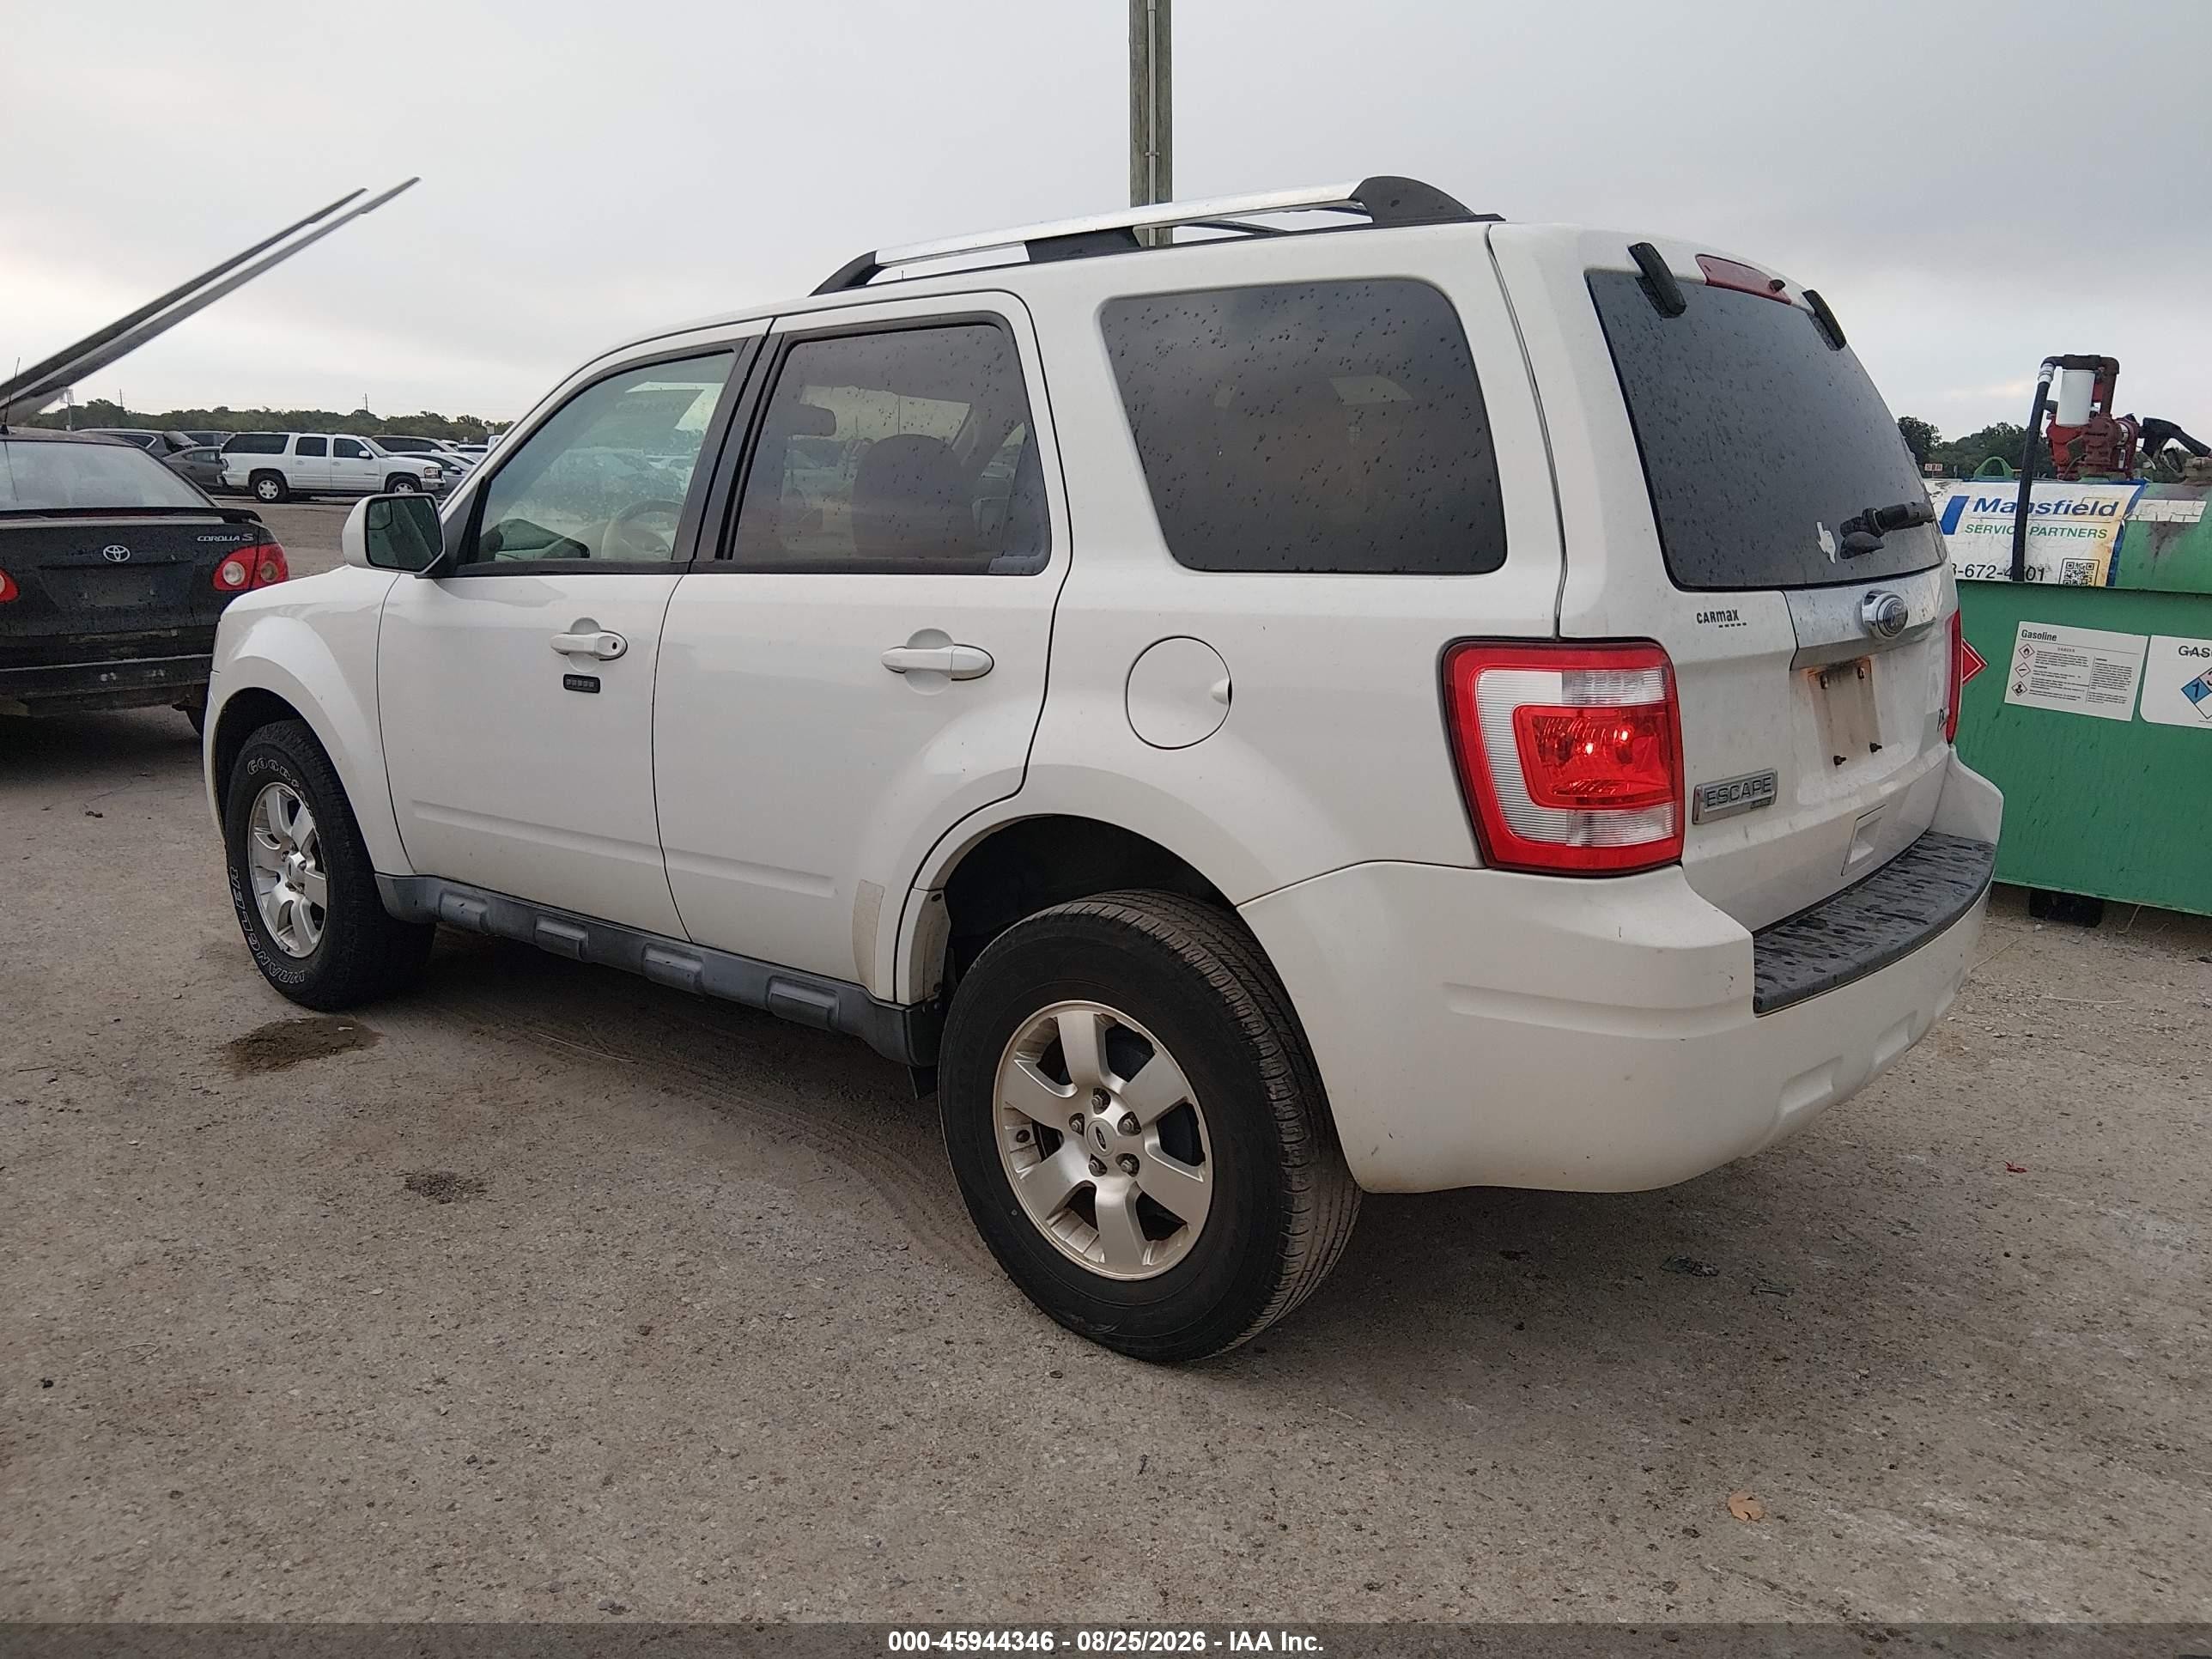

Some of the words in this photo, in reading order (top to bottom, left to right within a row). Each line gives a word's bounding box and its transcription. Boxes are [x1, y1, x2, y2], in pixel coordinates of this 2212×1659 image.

[241, 532, 254, 542] S
[1964, 524, 2016, 535] SERVIC
[2029, 526, 2108, 539] PARTNERS
[1951, 562, 2045, 581] -672-401
[2021, 629, 2057, 642] Gasoline
[2178, 645, 2212, 659] GAS
[1706, 775, 1772, 807] ESCAPE
[229, 866, 306, 984] WRANGLER
